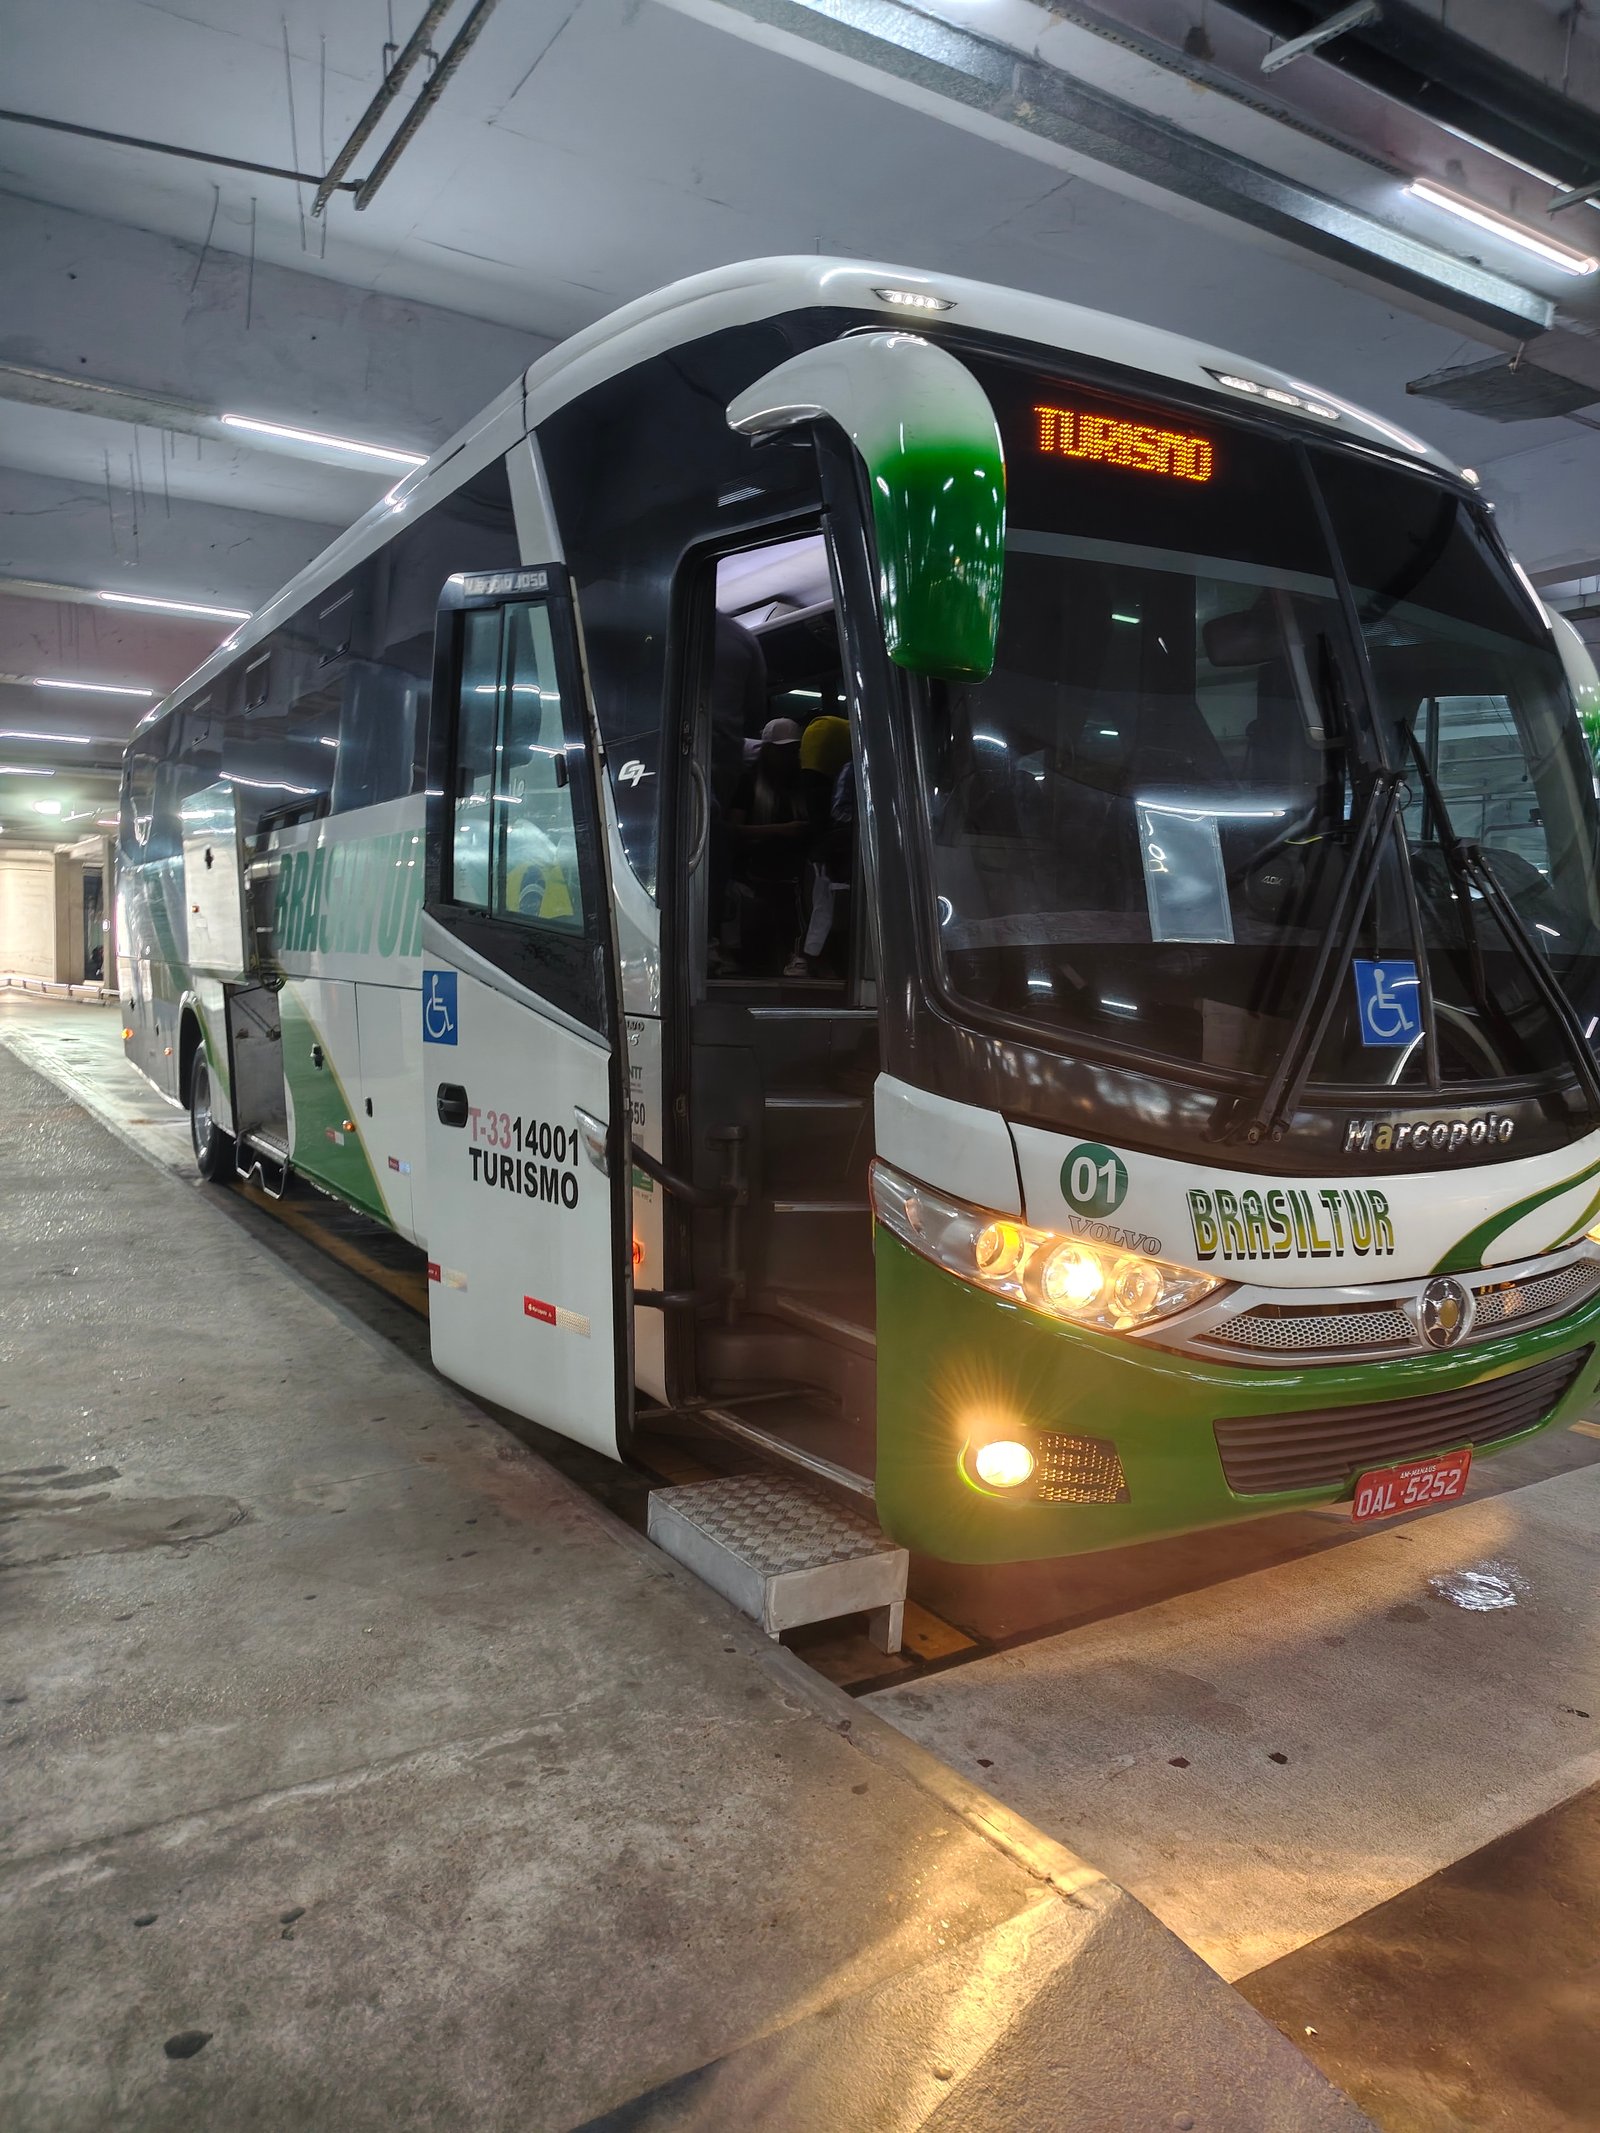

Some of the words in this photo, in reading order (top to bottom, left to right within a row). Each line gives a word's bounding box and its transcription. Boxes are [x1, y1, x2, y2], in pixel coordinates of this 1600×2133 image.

[1034, 405, 1212, 481] TURISMO
[514, 572, 547, 589] 1050
[1343, 1112, 1514, 1152] Marcopolo
[469, 1147, 579, 1209] TURISMO
[1070, 1156, 1117, 1203] 01
[1068, 1215, 1162, 1255] VOLVO
[1185, 1189, 1395, 1261] BRASILTUR
